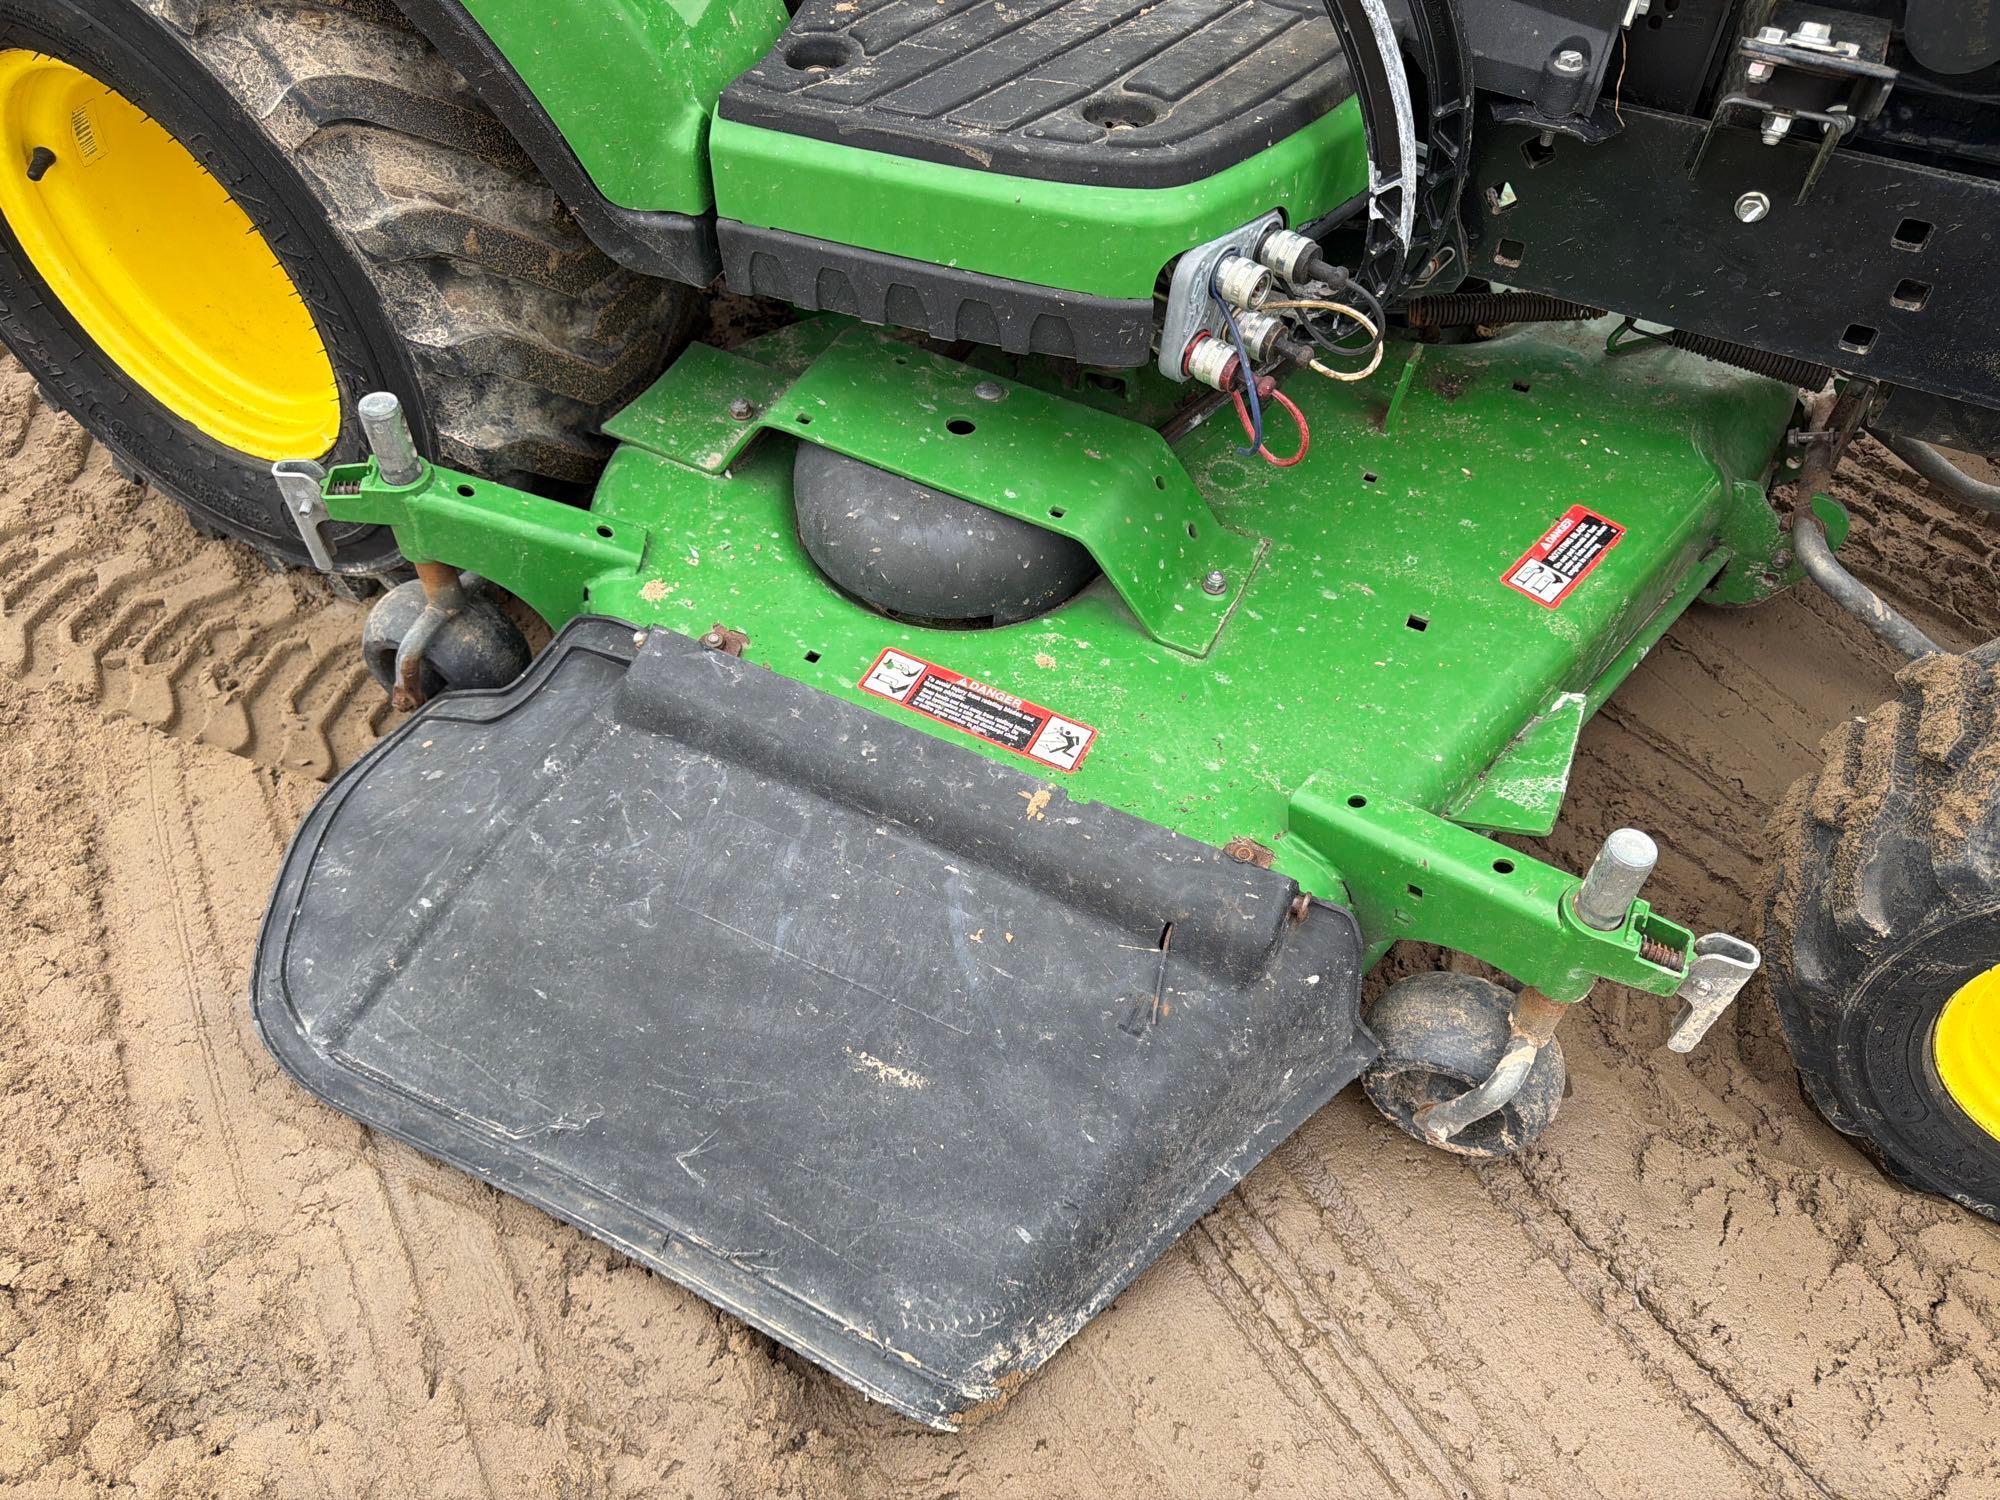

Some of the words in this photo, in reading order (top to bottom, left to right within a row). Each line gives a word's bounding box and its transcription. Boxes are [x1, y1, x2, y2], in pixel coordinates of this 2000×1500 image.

[1544, 518, 1573, 543] DANGER
[1547, 537, 1573, 561] ROTATING
[1569, 522, 1588, 538] BLADE
[934, 679, 951, 688] avoid
[950, 685, 967, 695] injury
[967, 692, 981, 700] from
[980, 698, 1003, 710] rotating
[1003, 707, 1022, 717] blades
[968, 681, 1023, 707] DANGER
